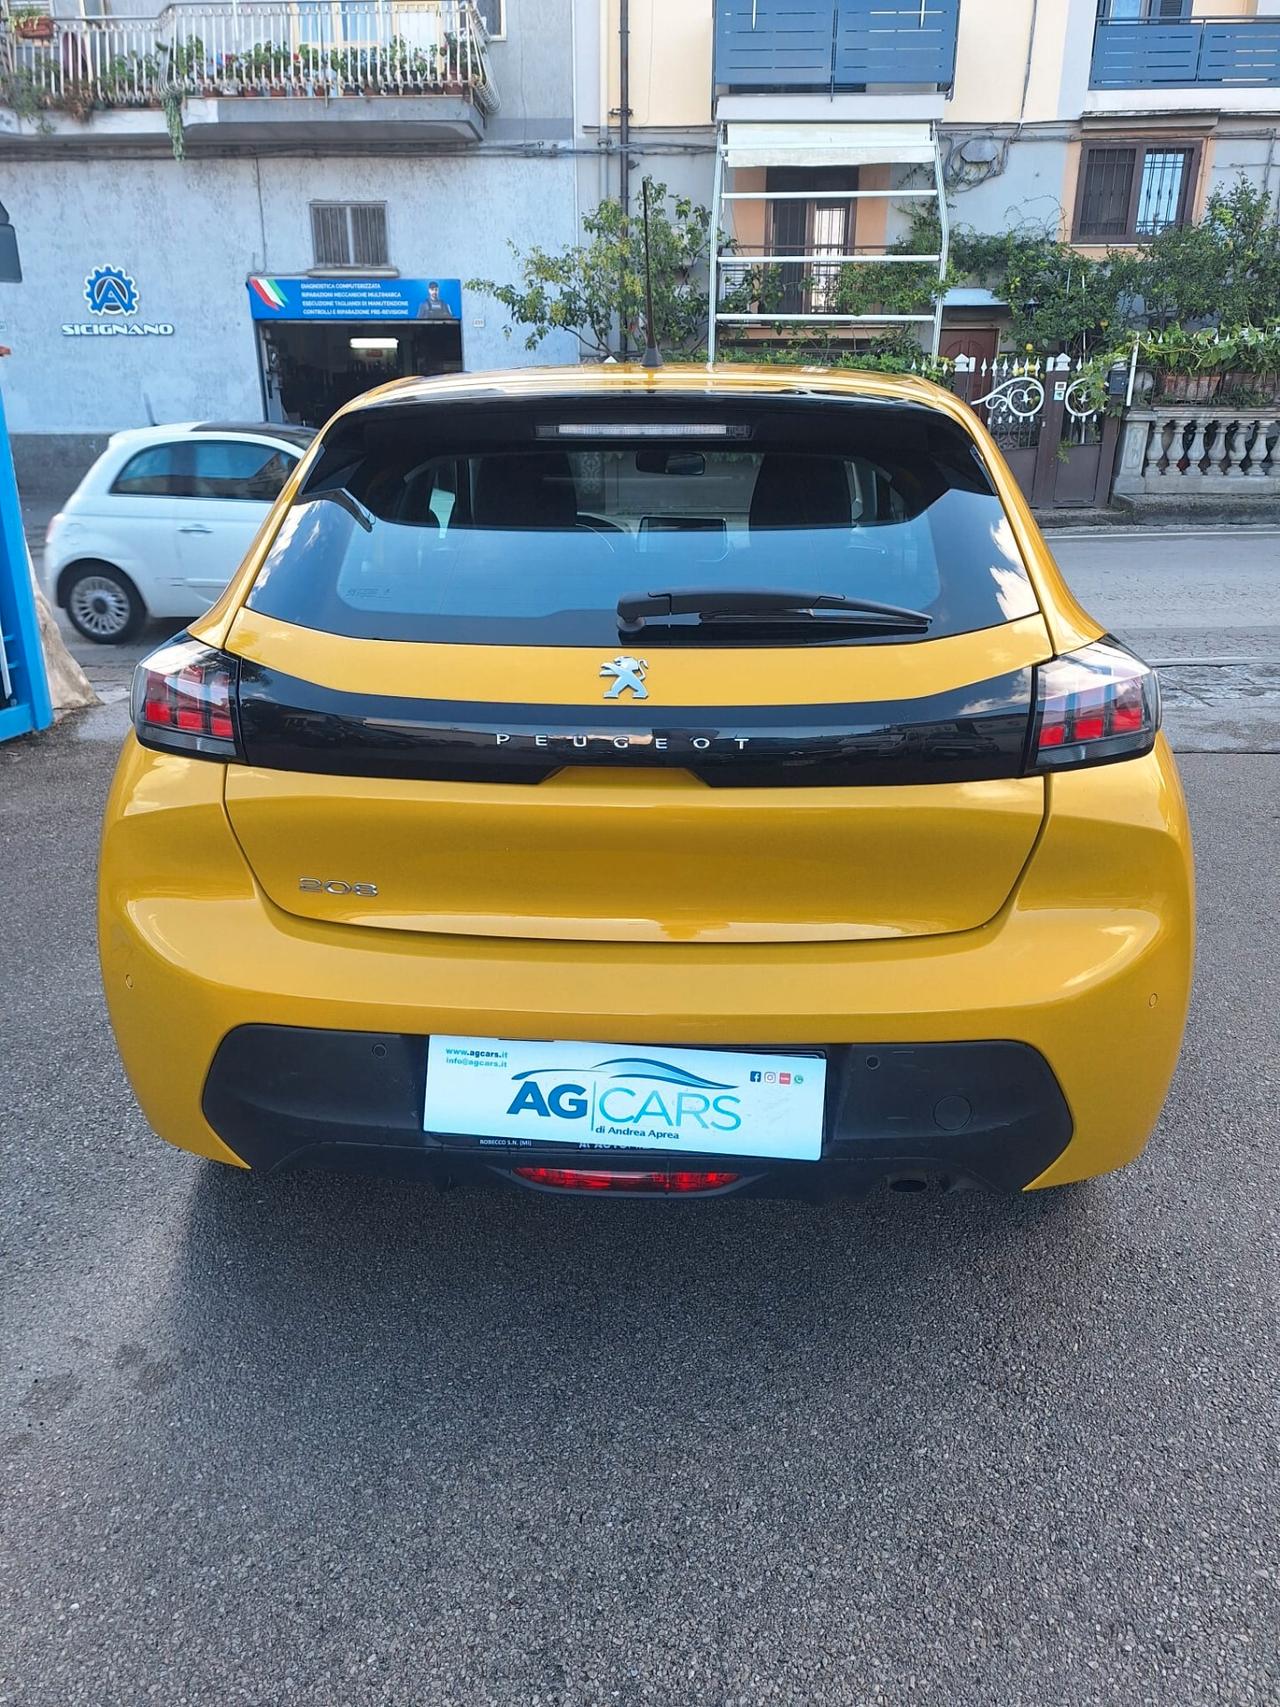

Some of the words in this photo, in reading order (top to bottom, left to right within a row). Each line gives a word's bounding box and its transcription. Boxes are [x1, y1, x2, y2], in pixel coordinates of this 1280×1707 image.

[62, 324, 174, 336] SICIGNANO
[496, 733, 750, 750] PEUGEOT
[299, 877, 378, 897] 208
[446, 1047, 508, 1060] www.agcars.it
[446, 1057, 508, 1068] info@agcars.it
[506, 1081, 588, 1119] AG
[599, 1087, 742, 1131] CARS
[595, 1126, 606, 1134] di
[608, 1126, 646, 1137] Andrea
[648, 1129, 680, 1140] Aprea
